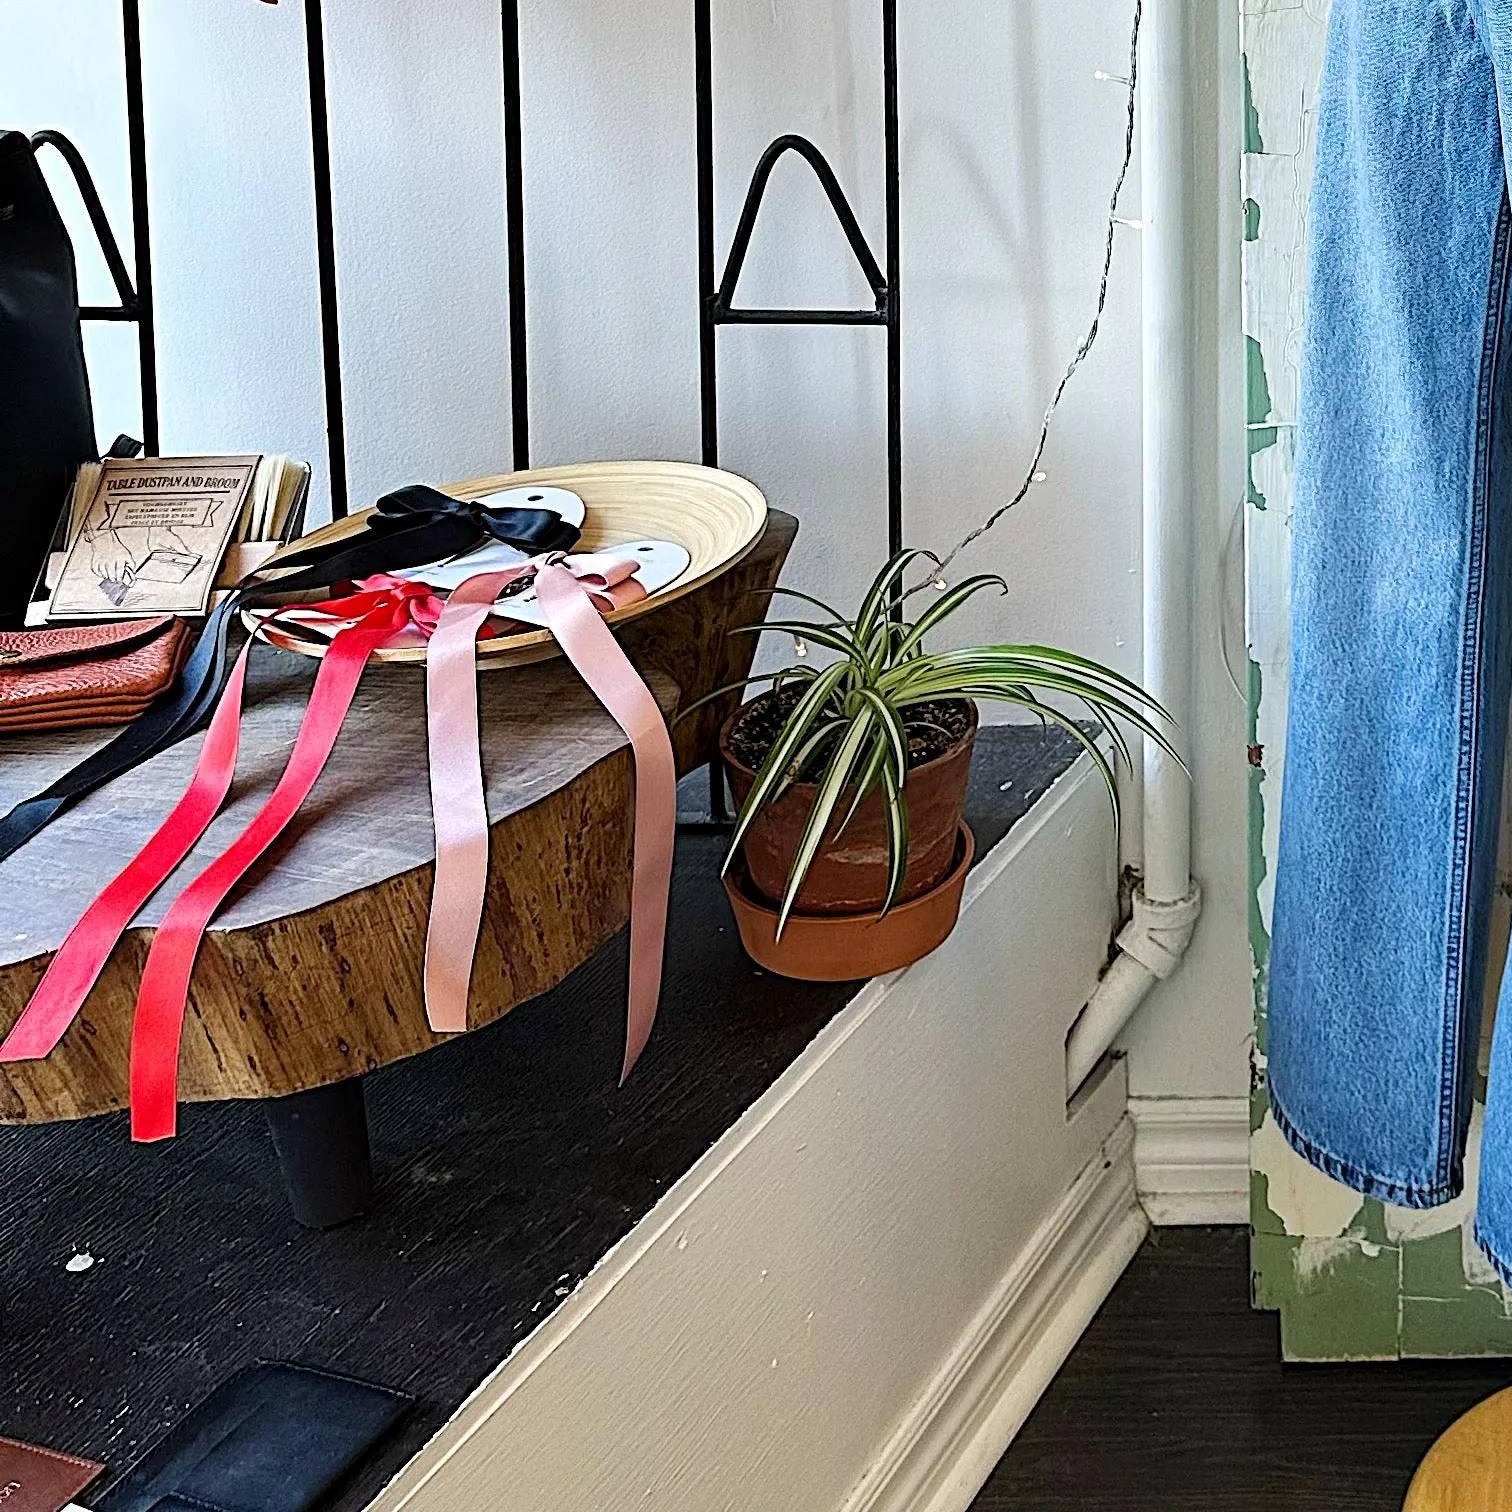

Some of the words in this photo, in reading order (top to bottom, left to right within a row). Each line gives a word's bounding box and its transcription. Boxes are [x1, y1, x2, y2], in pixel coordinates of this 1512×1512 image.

[106, 478, 137, 491] TABLE
[136, 476, 182, 489] DUSTPAN
[181, 476, 204, 488] AND
[203, 477, 241, 489] BROOM
